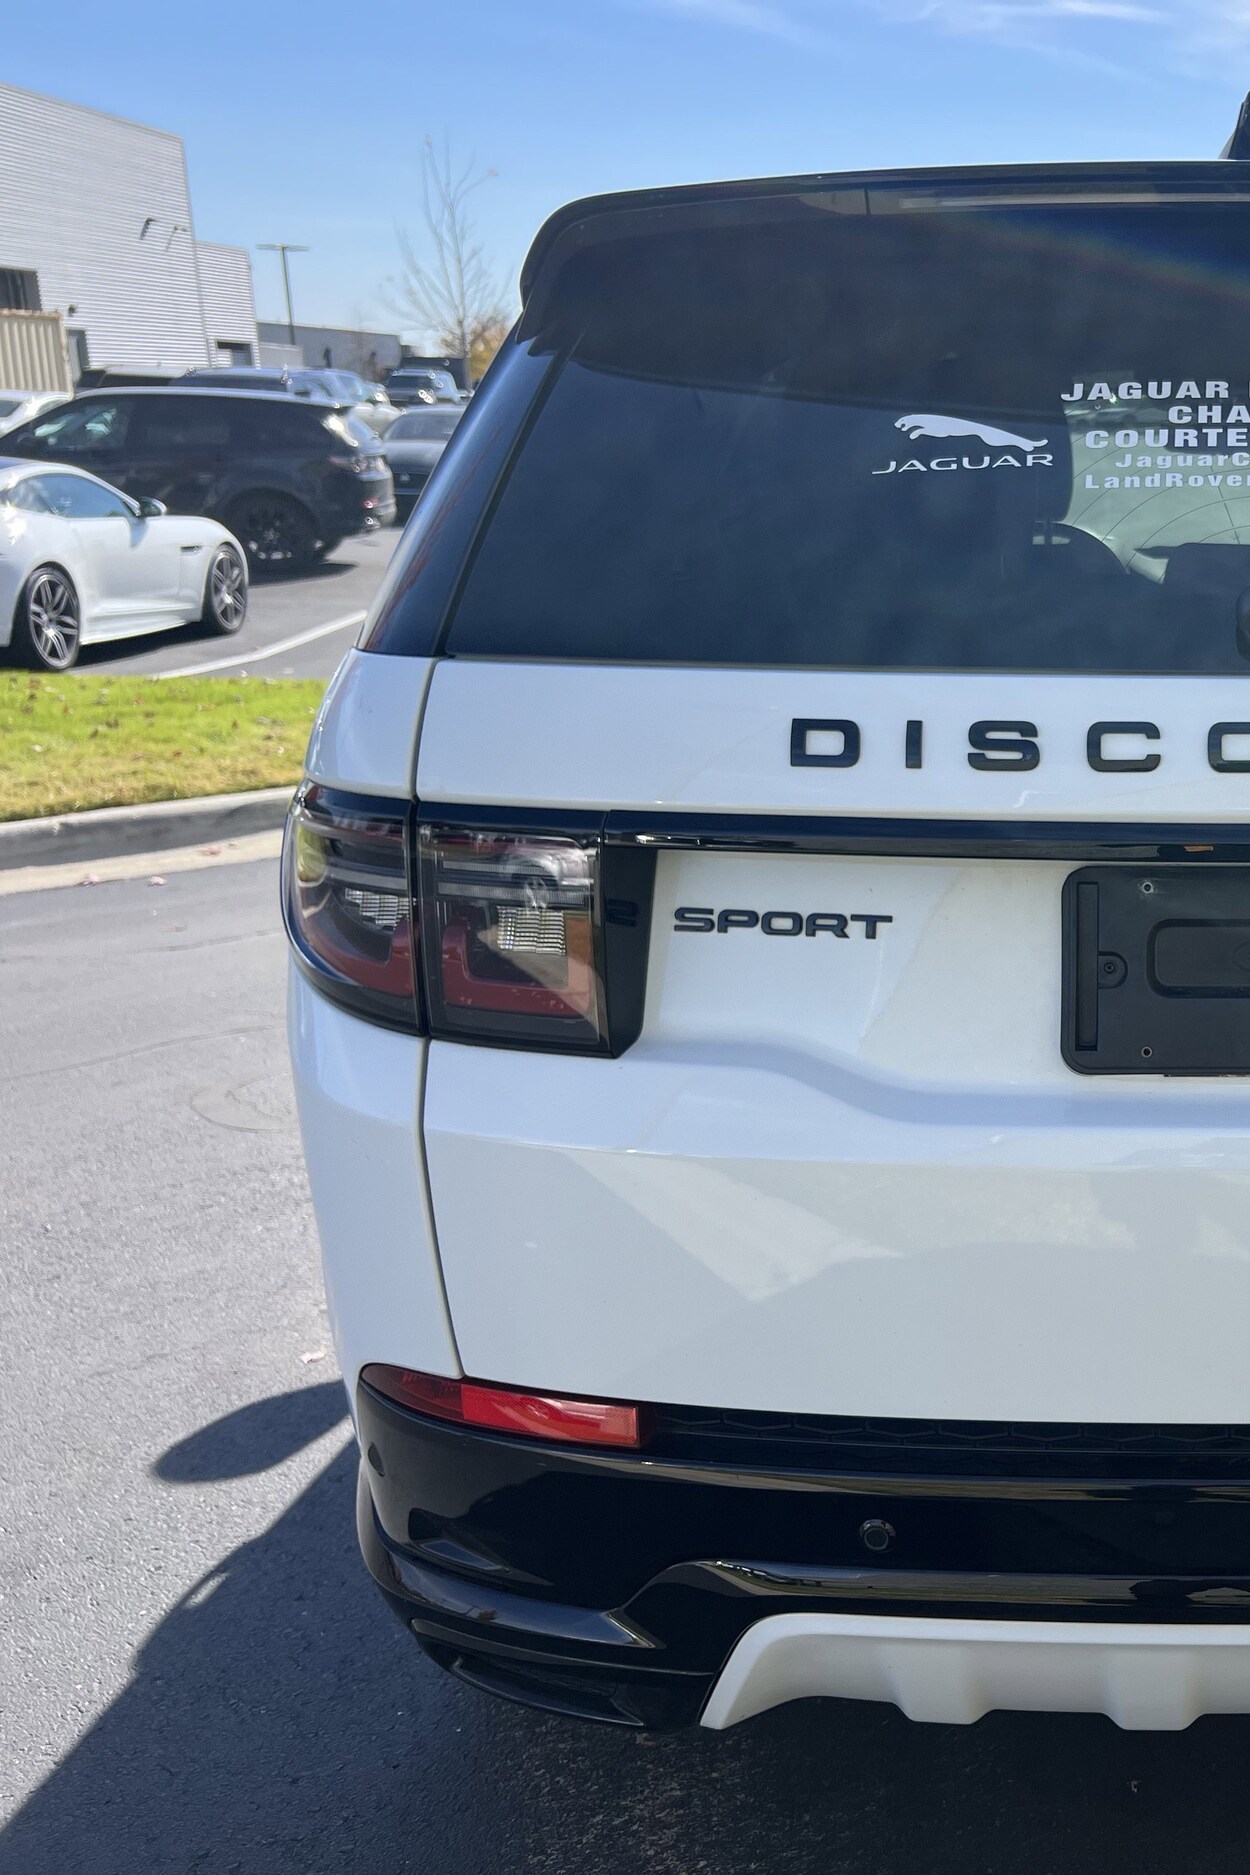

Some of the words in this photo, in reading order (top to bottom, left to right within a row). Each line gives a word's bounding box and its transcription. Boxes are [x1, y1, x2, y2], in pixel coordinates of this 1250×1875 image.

[1060, 381, 1230, 401] JAGUAR
[871, 454, 1054, 475] JAGUAR
[673, 906, 893, 940] SPORT
